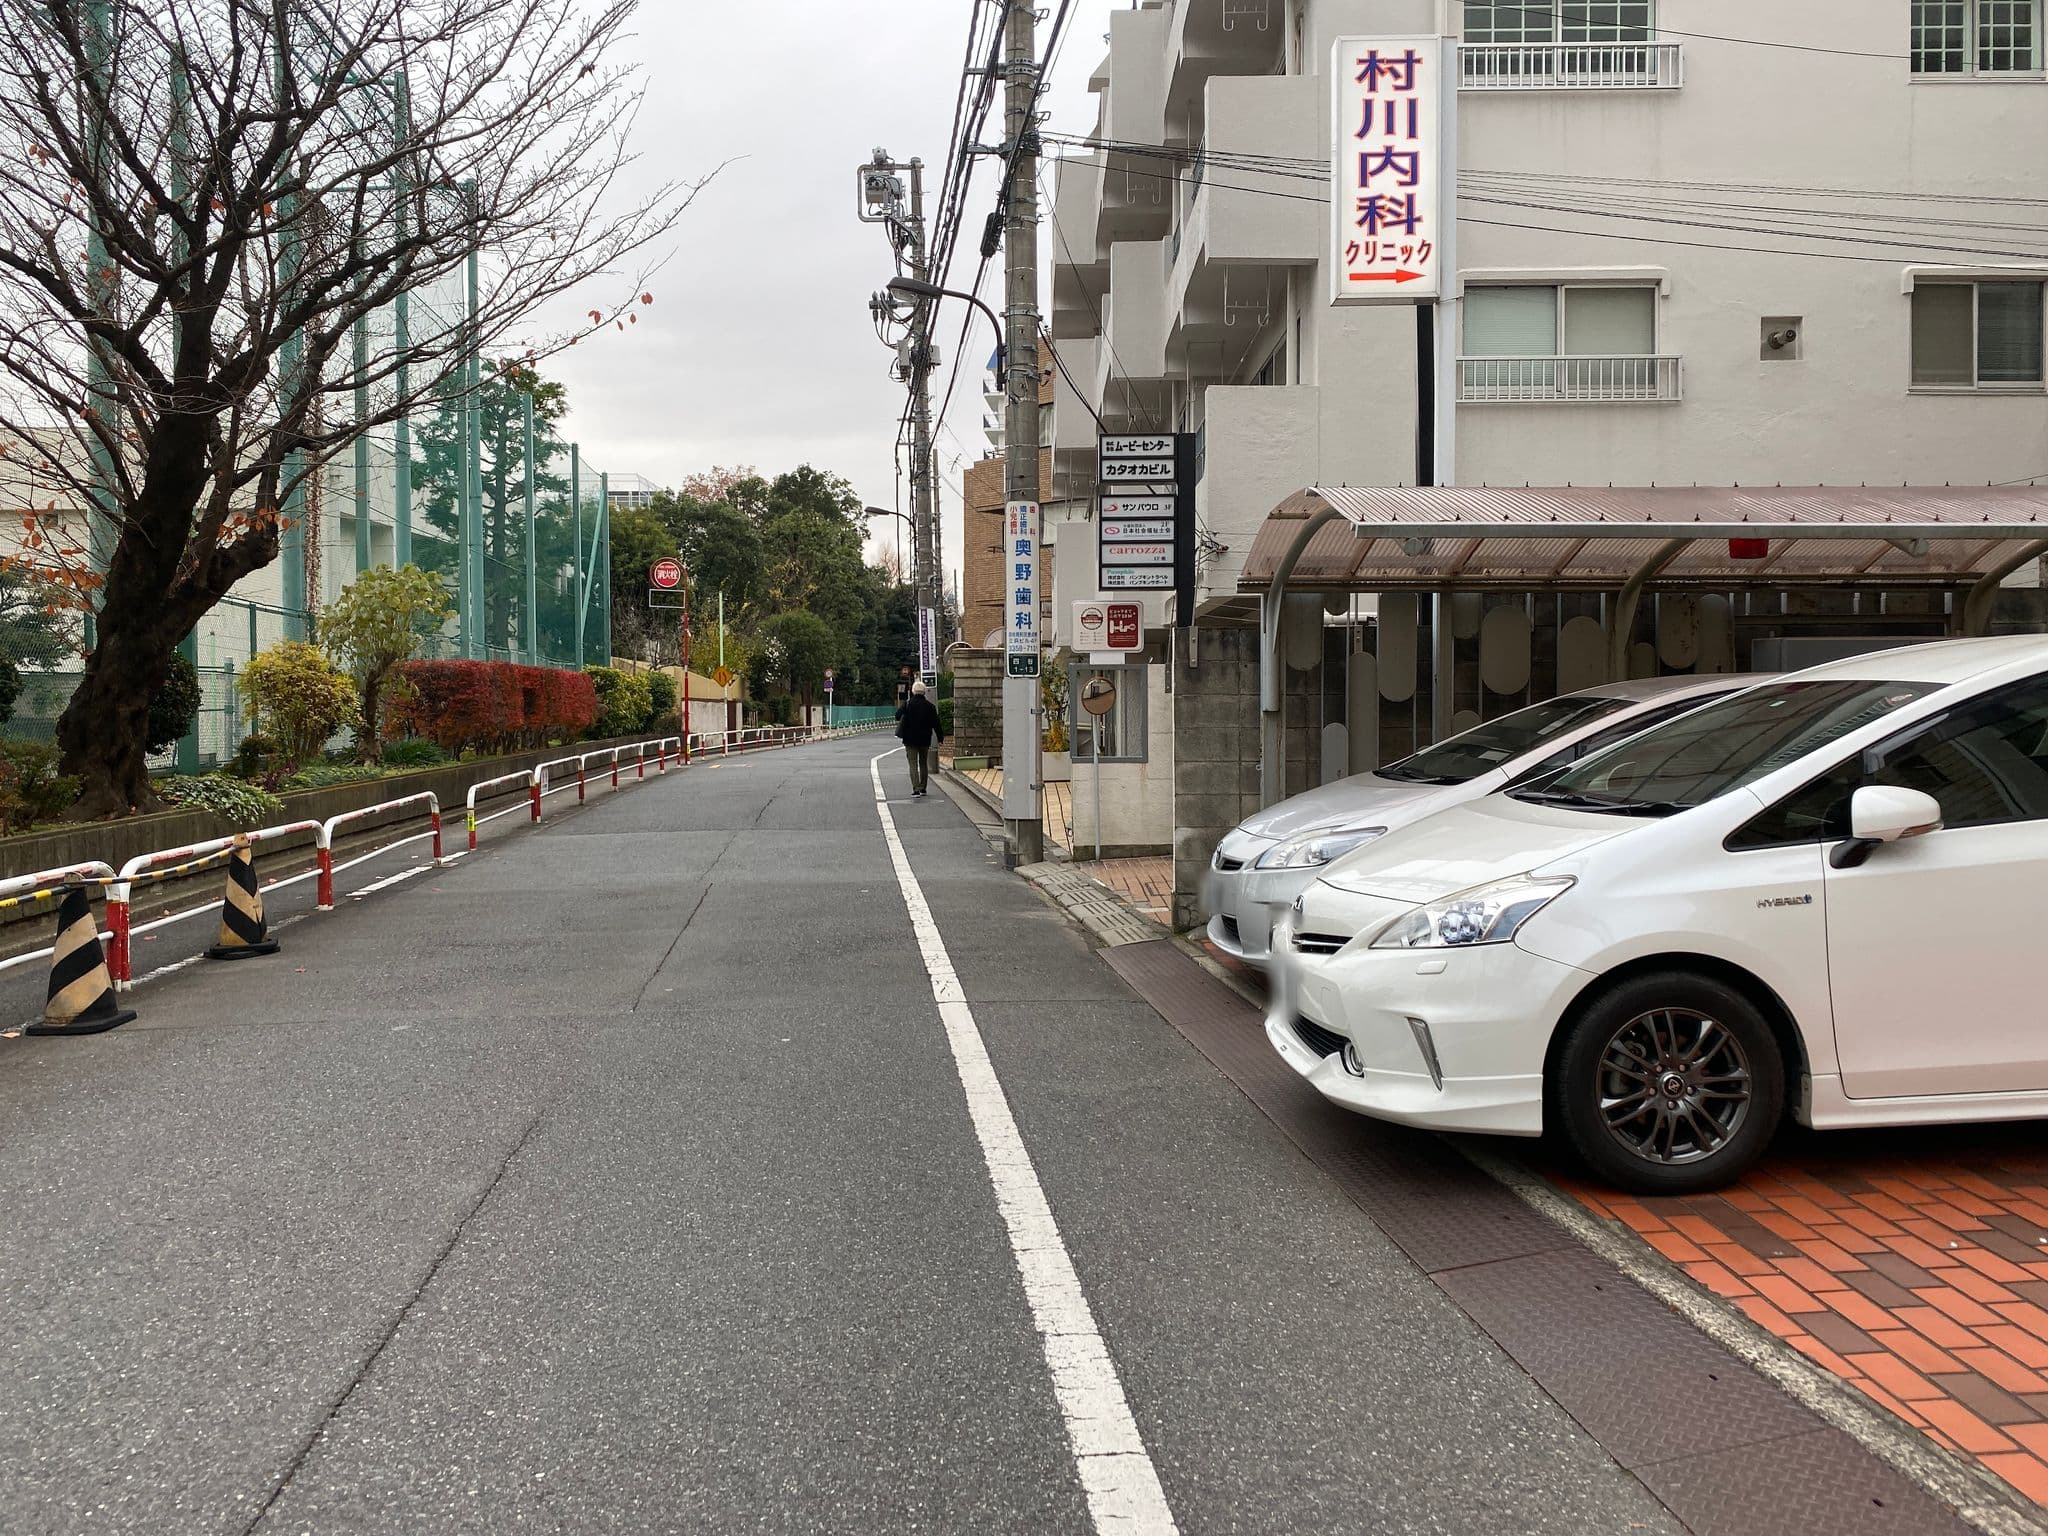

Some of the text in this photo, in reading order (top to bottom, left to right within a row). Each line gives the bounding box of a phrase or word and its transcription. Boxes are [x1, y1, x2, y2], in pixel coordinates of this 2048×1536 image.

[1354, 49, 1424, 237] 村川内科
[1345, 239, 1432, 265] クリニック
[1115, 440, 1170, 452] ムービーセンター
[1106, 463, 1171, 476] カタオカビル
[1122, 503, 1159, 511] サンパウロ
[1109, 546, 1166, 555] carrozza
[657, 569, 678, 580] 消火栓
[1015, 539, 1032, 630] 奥野歯科
[1757, 897, 1803, 908] HYBRID
